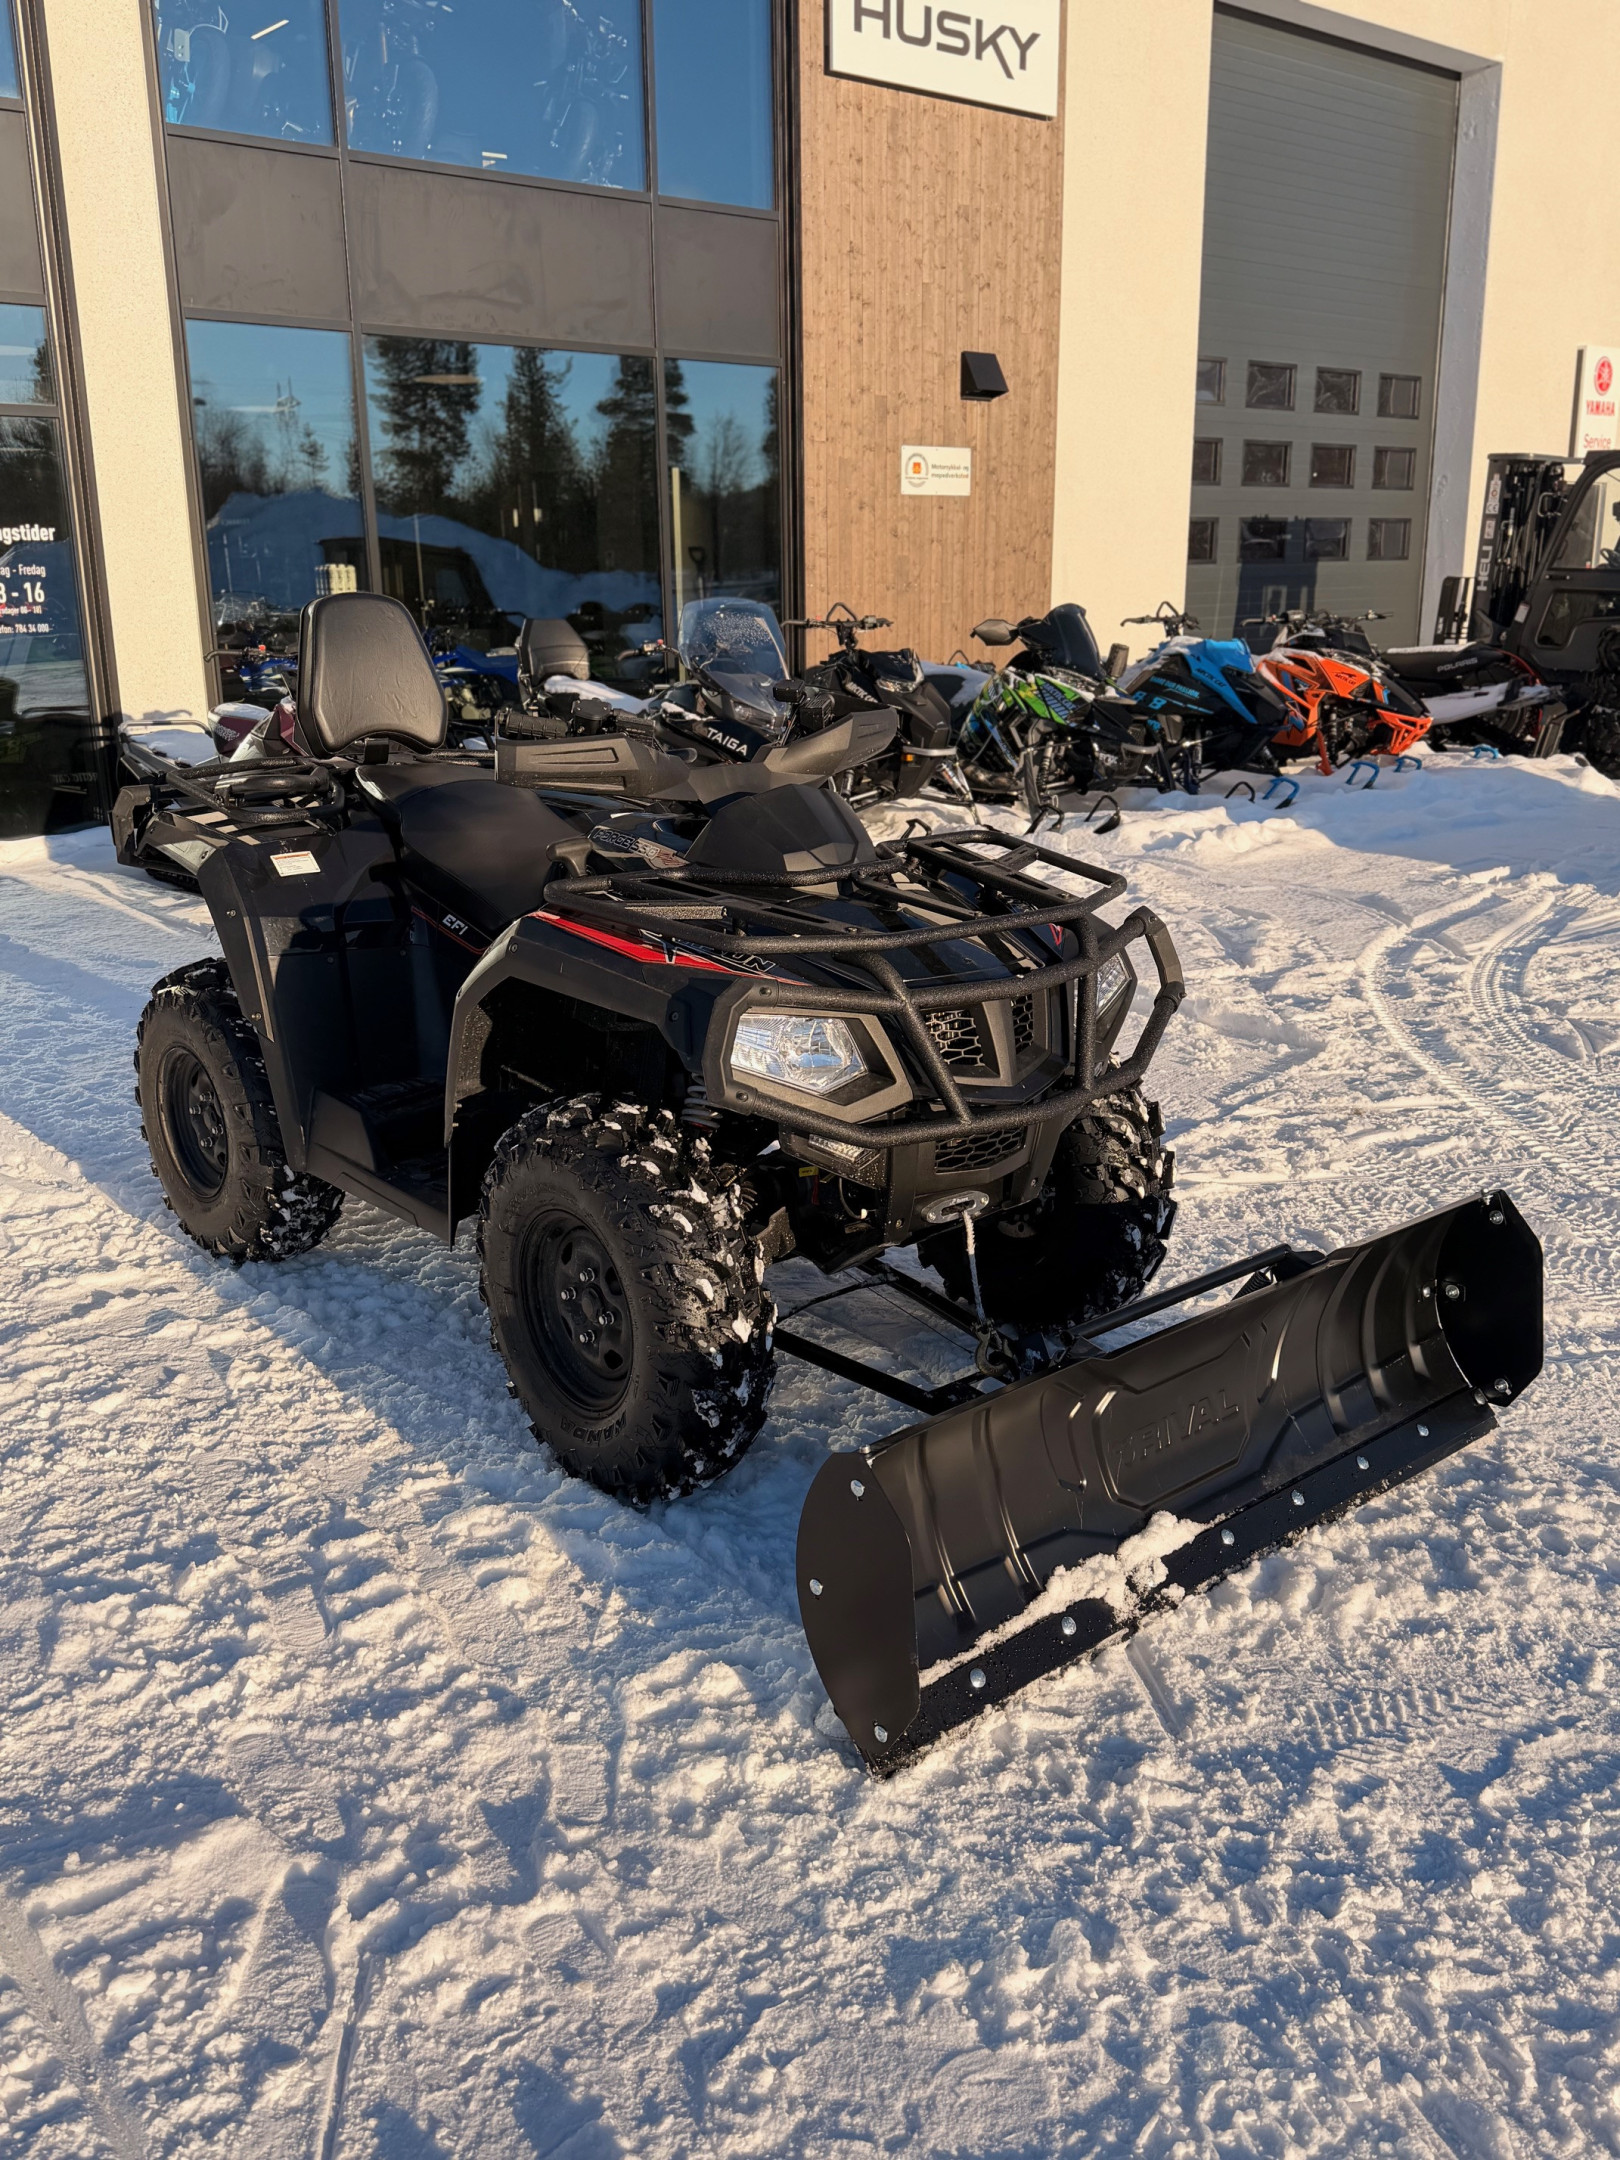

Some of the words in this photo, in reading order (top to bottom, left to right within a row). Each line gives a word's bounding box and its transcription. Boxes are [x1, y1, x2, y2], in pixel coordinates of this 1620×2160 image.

[853, 0, 1041, 80] HUSKY
[1586, 399, 1615, 416] YAMAHA
[1583, 433, 1612, 449] Service
[18, 563, 47, 578] Fredag
[1477, 545, 1493, 591] HELI
[23, 581, 45, 603] 16
[1437, 657, 1478, 672] POLARIS
[707, 727, 748, 757] TAIGA
[442, 913, 468, 935] EFI
